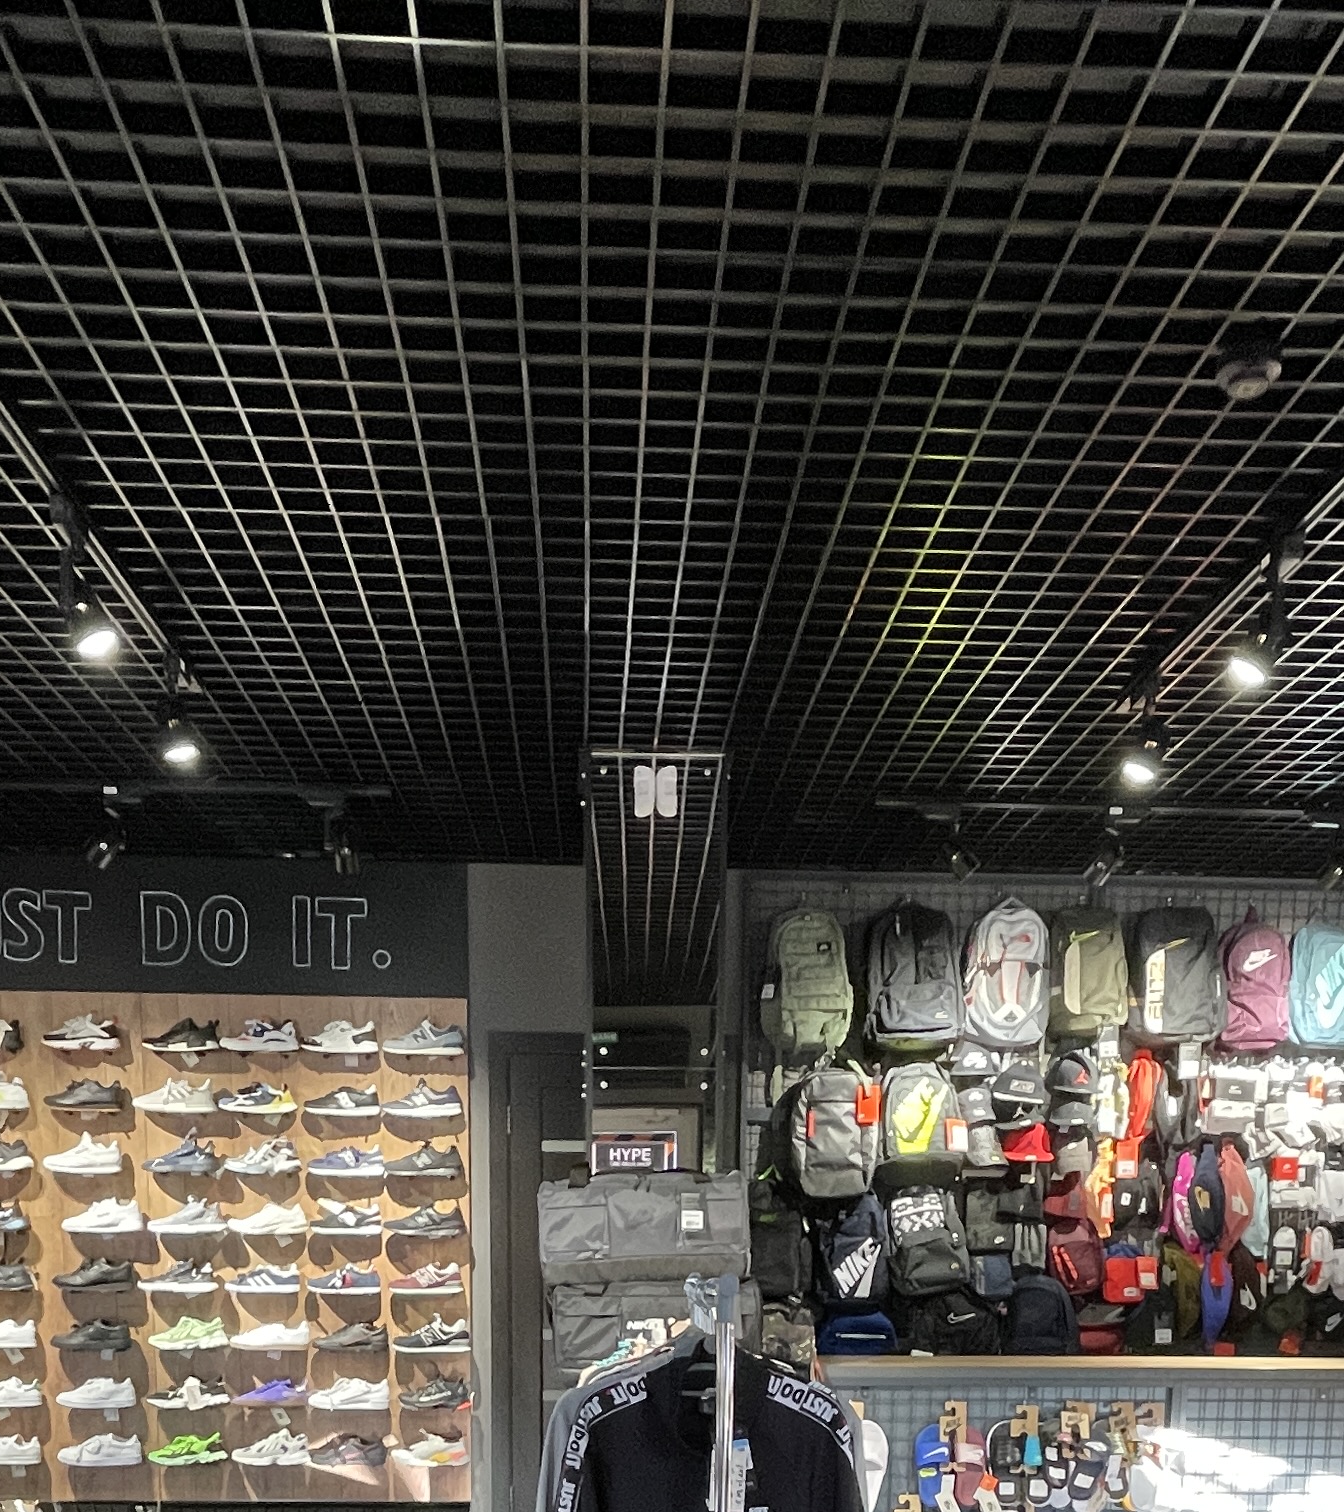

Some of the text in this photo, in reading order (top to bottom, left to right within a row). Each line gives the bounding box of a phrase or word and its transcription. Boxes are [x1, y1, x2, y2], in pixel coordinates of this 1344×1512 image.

[140, 890, 249, 967] DO
[291, 895, 392, 970] IT.
[608, 1147, 653, 1162] HYPE
[833, 1236, 876, 1294] NIKE
[781, 1382, 805, 1405] DO
[802, 1393, 839, 1423] JUST
[570, 1430, 587, 1452] DO
